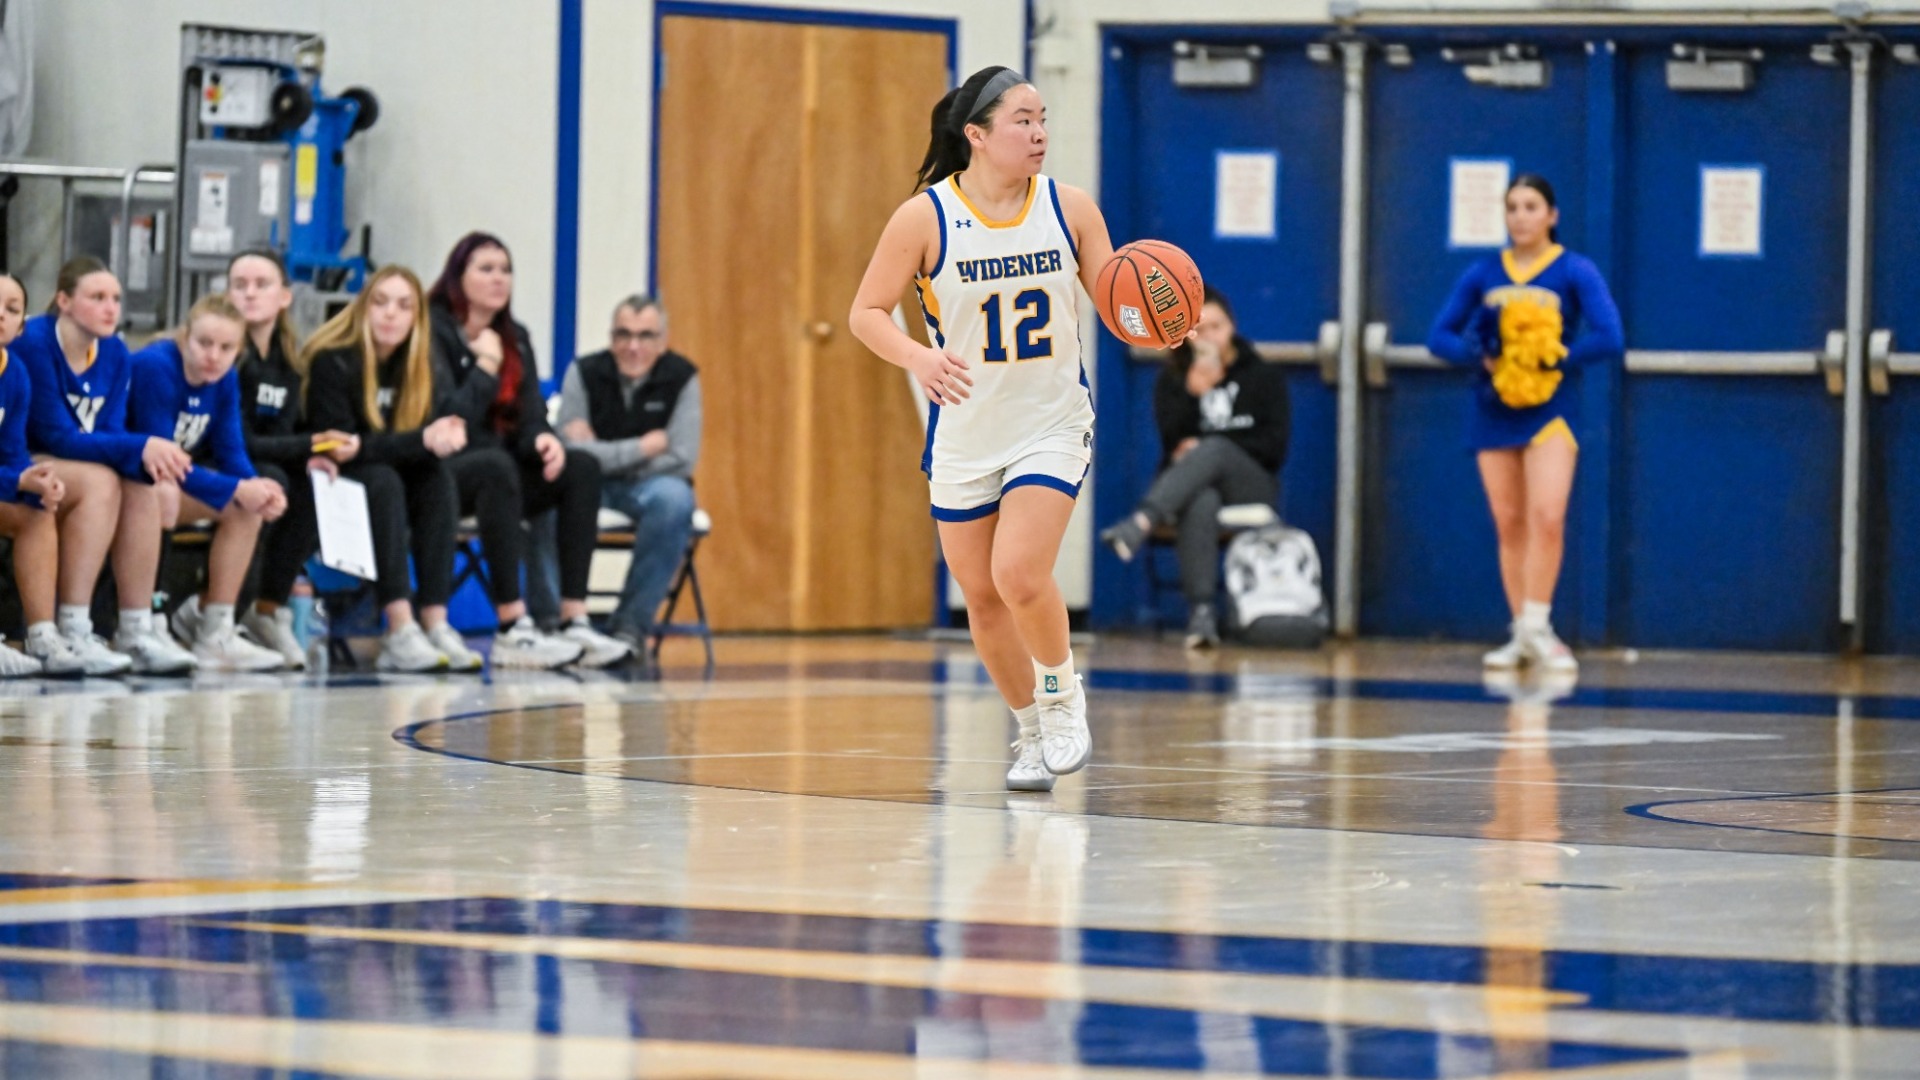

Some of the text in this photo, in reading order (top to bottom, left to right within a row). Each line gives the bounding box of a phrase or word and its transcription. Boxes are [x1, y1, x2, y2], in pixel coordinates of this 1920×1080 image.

[956, 249, 1063, 283] WIDENER
[1145, 268, 1180, 315] ROCK
[979, 287, 1053, 363] 12
